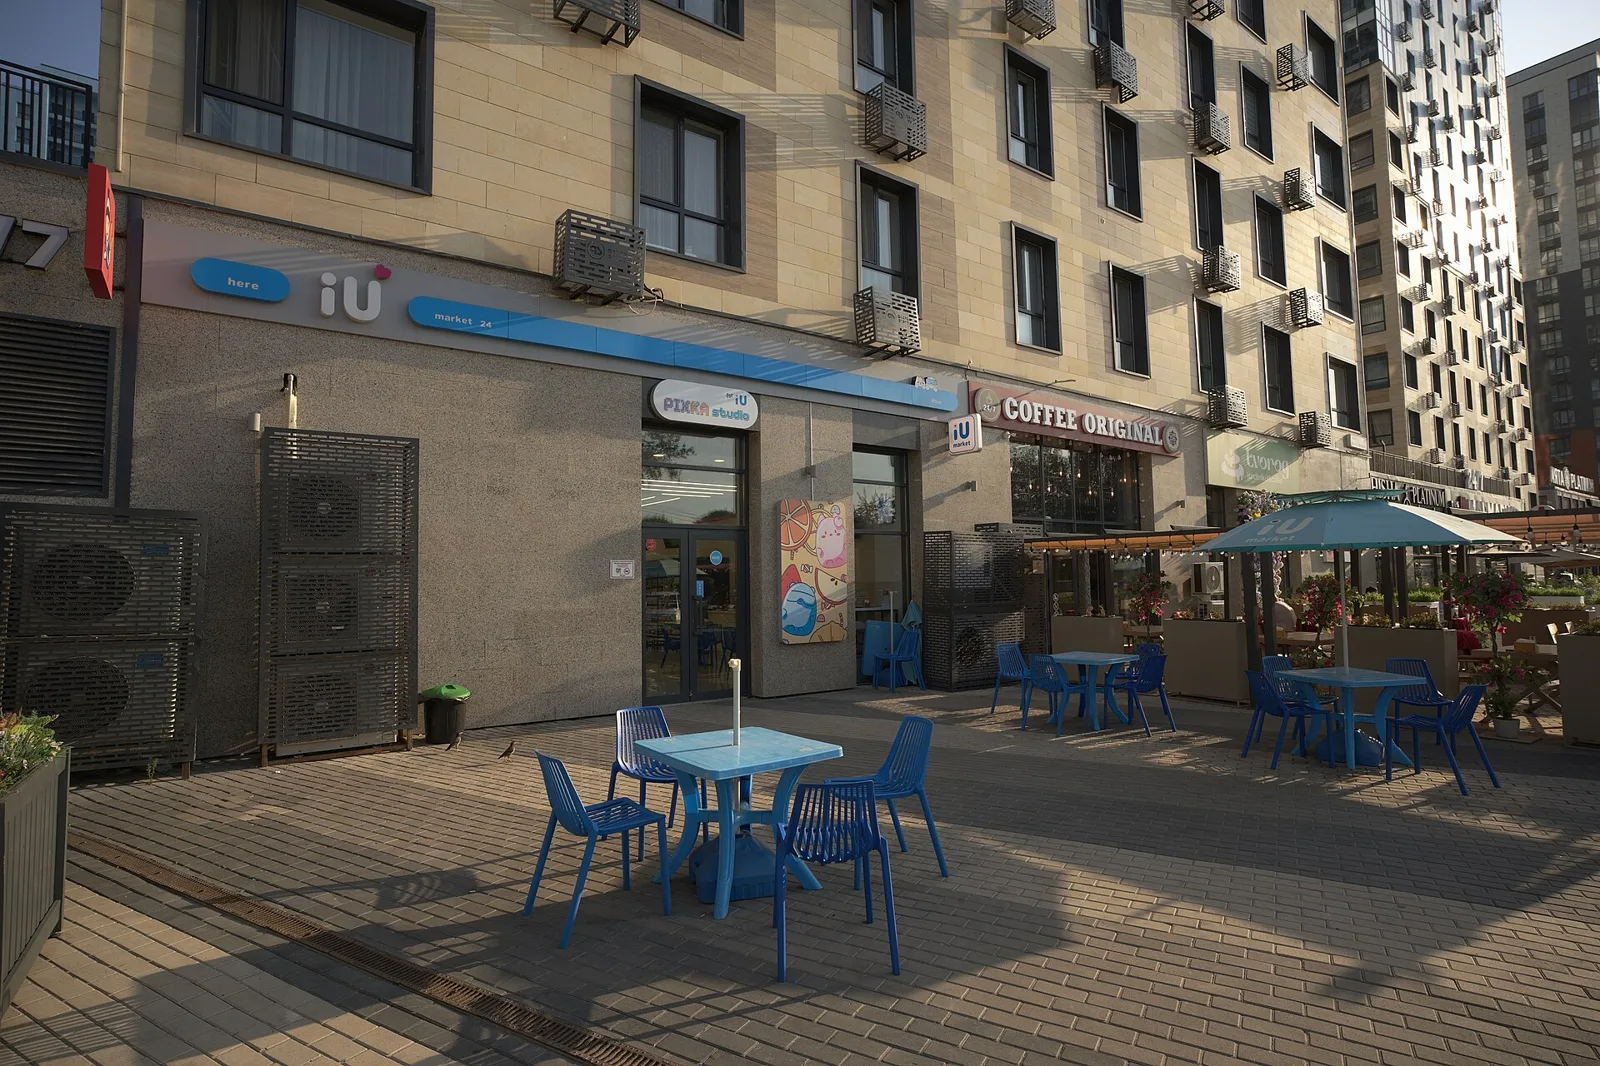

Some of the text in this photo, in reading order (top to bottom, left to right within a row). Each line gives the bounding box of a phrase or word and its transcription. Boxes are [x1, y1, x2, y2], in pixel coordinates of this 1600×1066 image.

[227, 277, 259, 290] here
[321, 272, 382, 322] iU
[434, 313, 492, 328] market 24
[712, 407, 750, 422] studio
[1003, 397, 1163, 446] COFFEE ORIGINAL
[952, 441, 971, 449] market
[1412, 485, 1445, 508] PLATINUM
[1245, 535, 1296, 543] market
